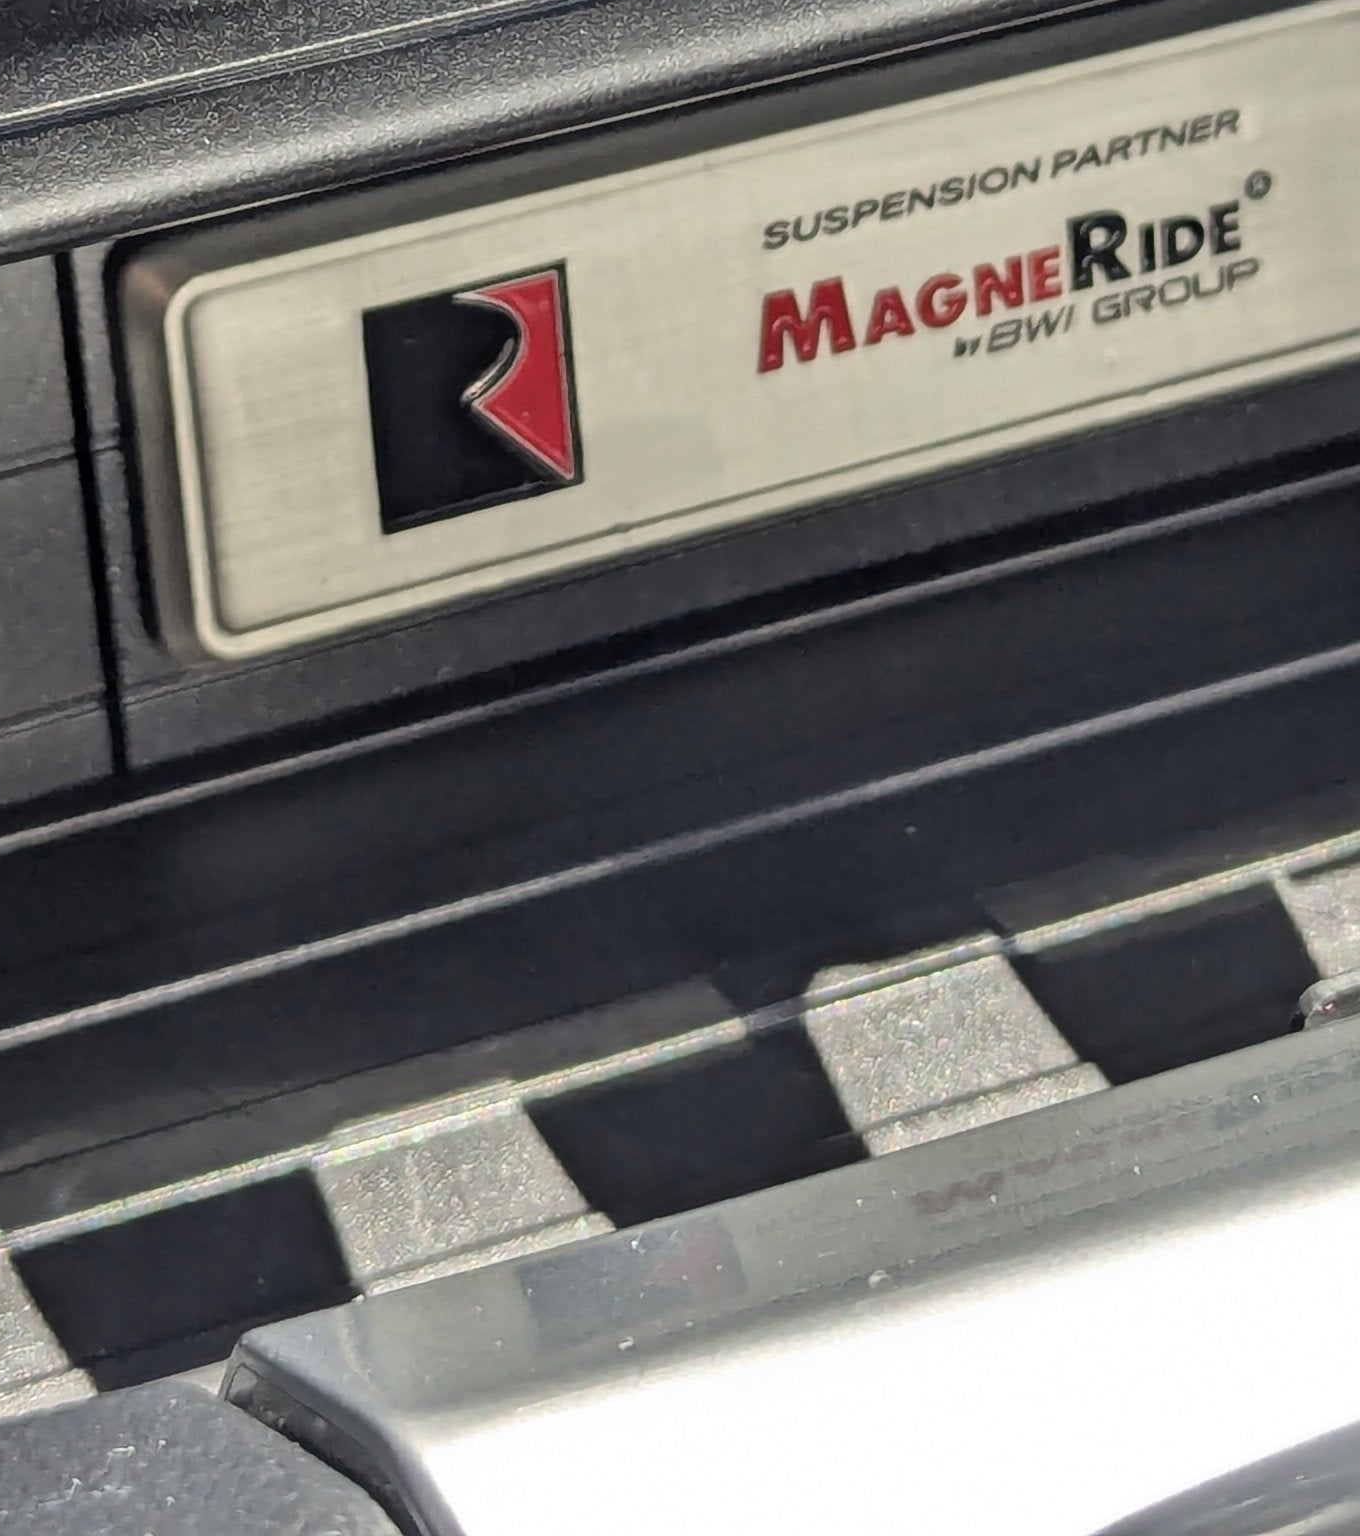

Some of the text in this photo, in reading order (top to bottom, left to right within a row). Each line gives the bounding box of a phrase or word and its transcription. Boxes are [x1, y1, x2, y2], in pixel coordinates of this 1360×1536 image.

[762, 109, 1240, 251] SUSPENSION PARTNER
[986, 304, 1077, 354] BWI
[1092, 258, 1261, 325] GROUP
